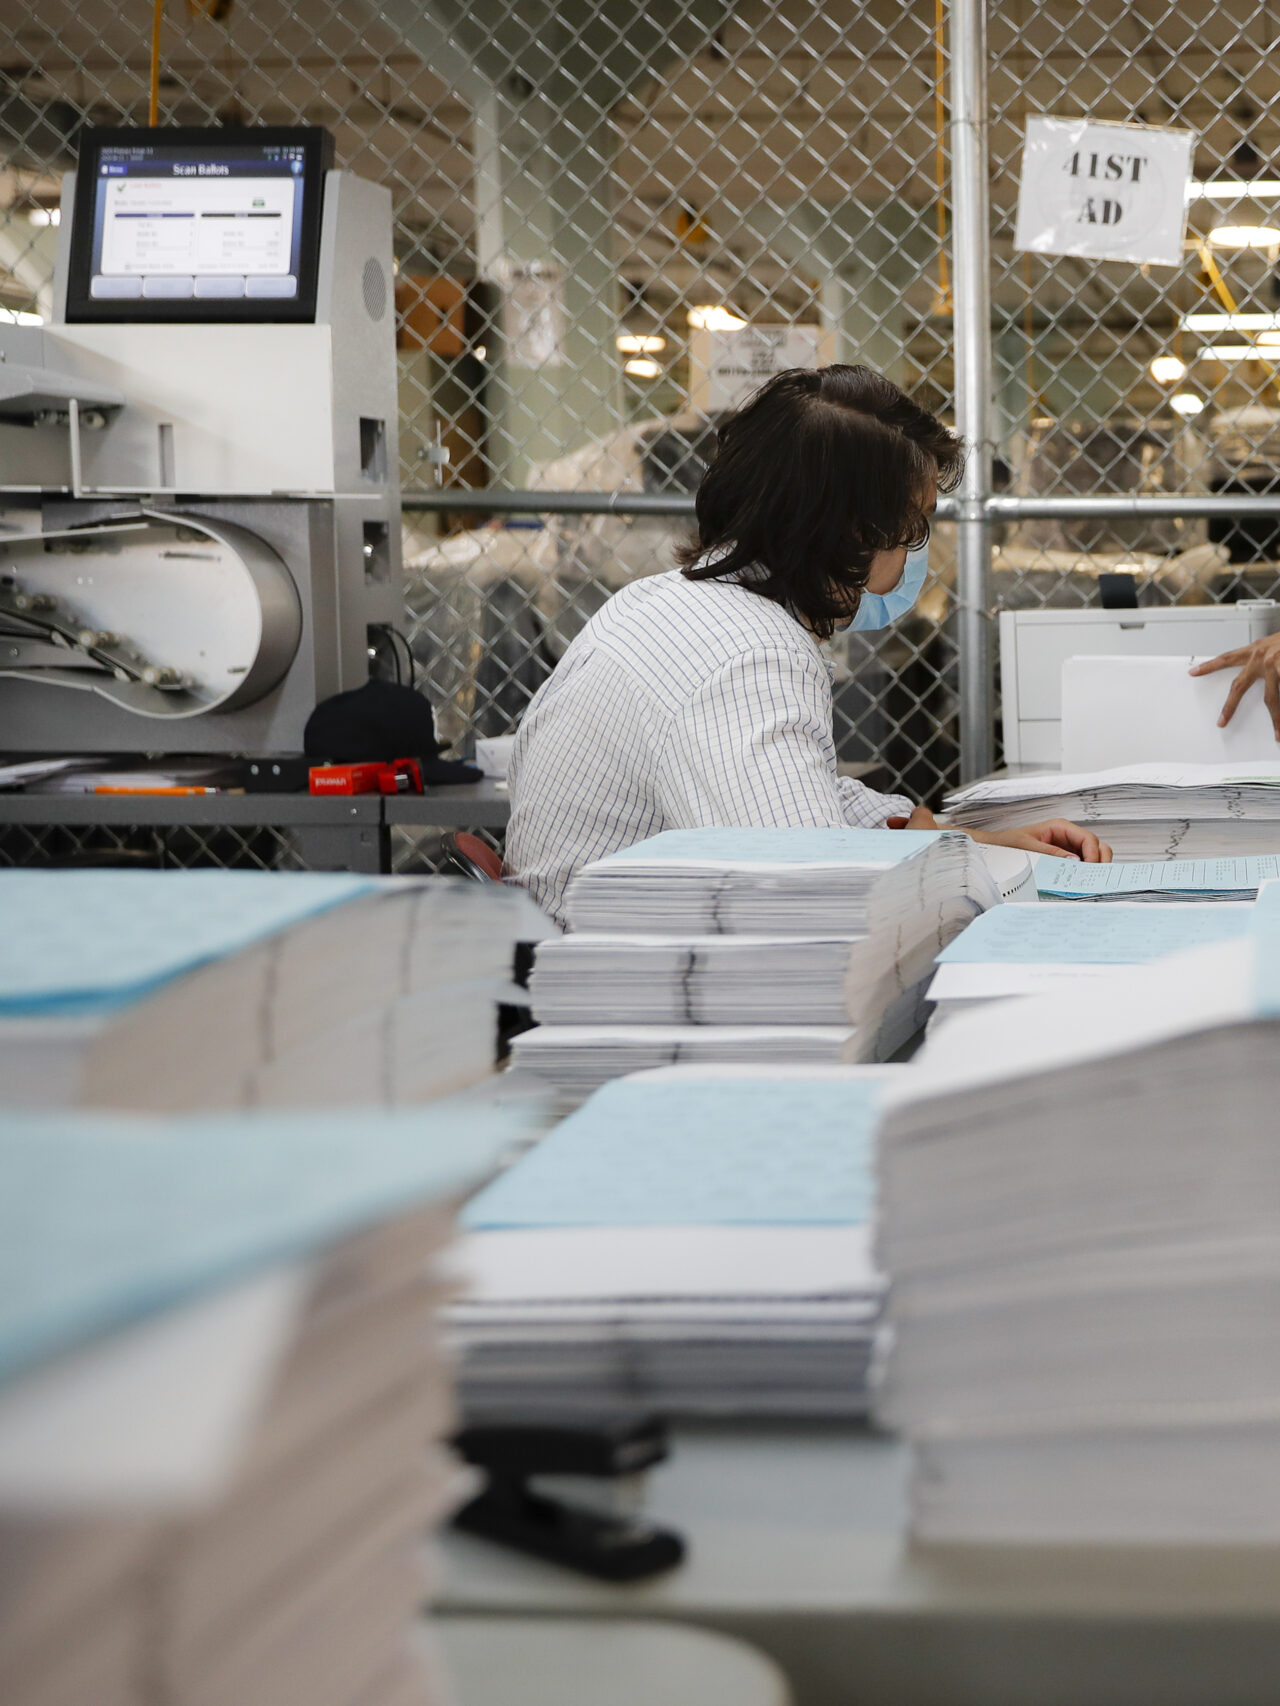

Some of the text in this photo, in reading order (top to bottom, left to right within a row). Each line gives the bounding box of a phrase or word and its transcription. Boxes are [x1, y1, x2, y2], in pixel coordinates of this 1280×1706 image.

[173, 163, 230, 176] Scan Ballots
[1062, 151, 1148, 182] 41ST
[1077, 197, 1123, 226] AD
